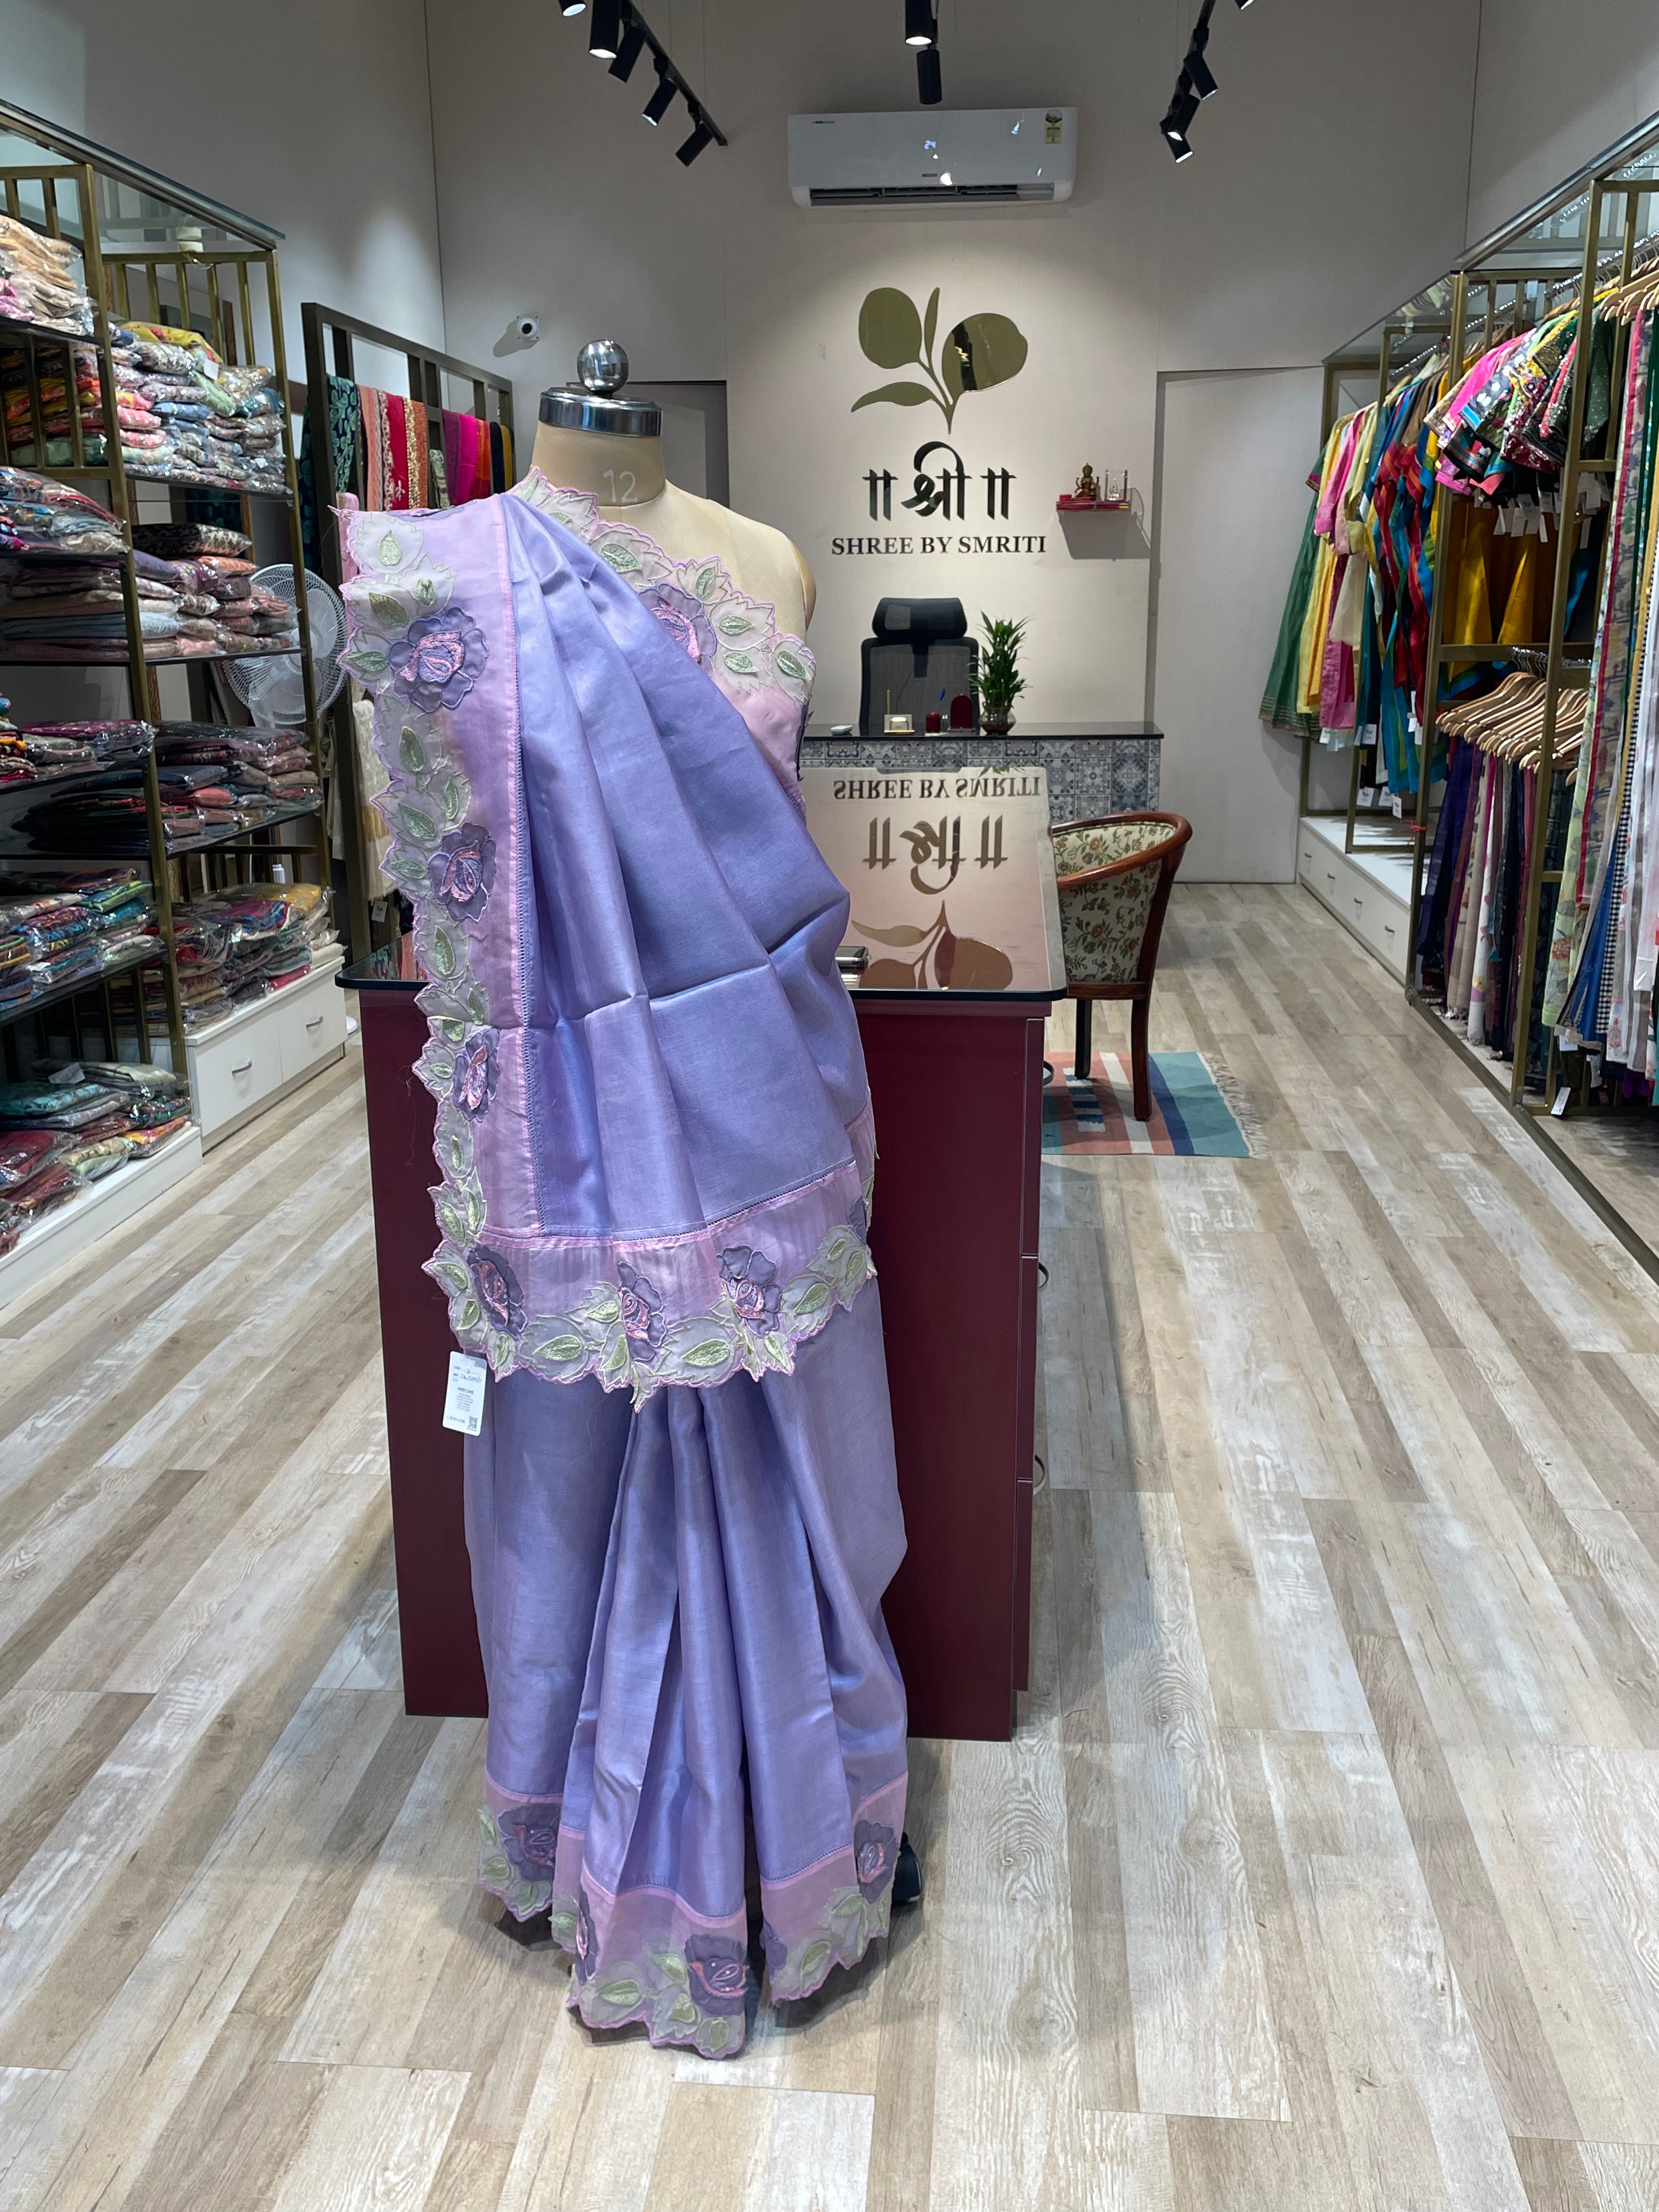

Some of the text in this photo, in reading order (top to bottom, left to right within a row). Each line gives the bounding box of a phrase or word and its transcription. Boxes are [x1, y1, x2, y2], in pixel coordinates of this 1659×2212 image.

[924, 139, 936, 150] 24
[602, 469, 639, 503] 12
[831, 536, 1046, 555] SHREE BY SMRITI
